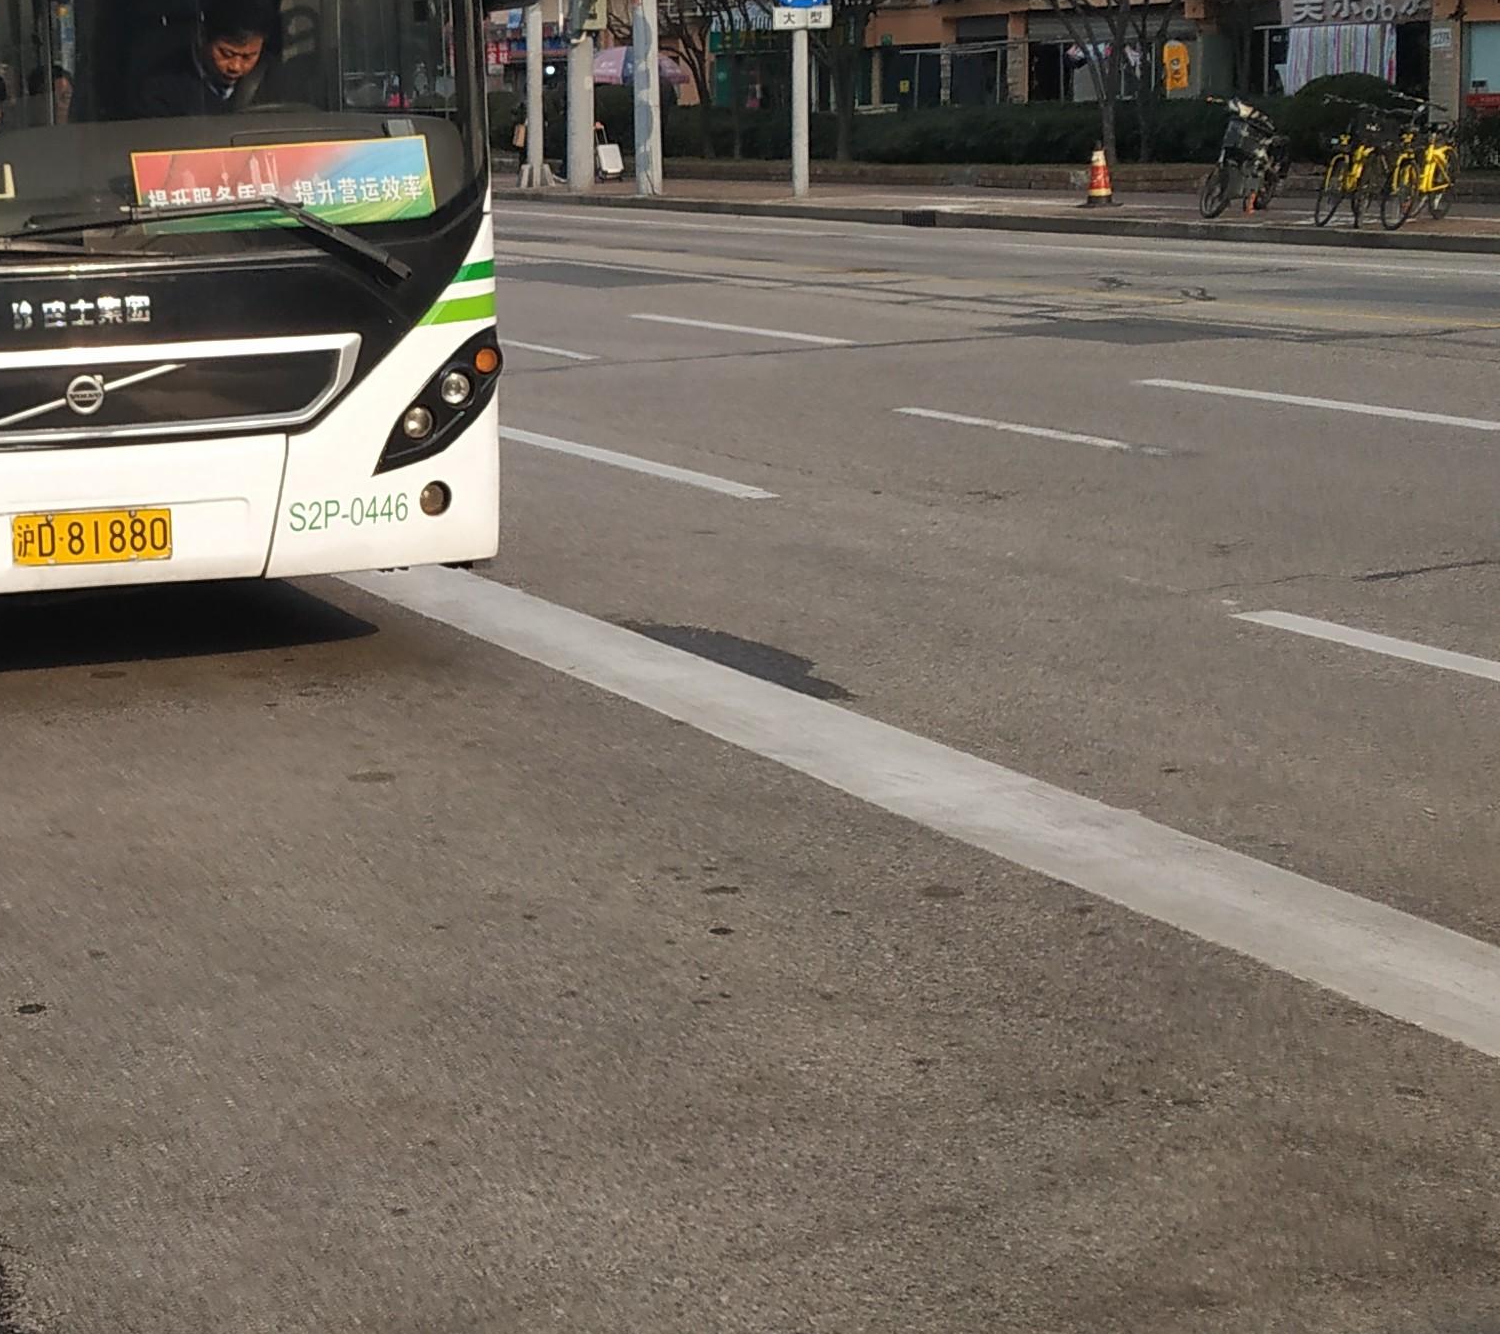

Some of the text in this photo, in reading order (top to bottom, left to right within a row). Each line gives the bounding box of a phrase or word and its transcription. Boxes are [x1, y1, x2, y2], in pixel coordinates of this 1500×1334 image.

[783, 10, 823, 25] 大型
[293, 174, 423, 206] 提升营运效率
[289, 492, 409, 533] S2P-0446
